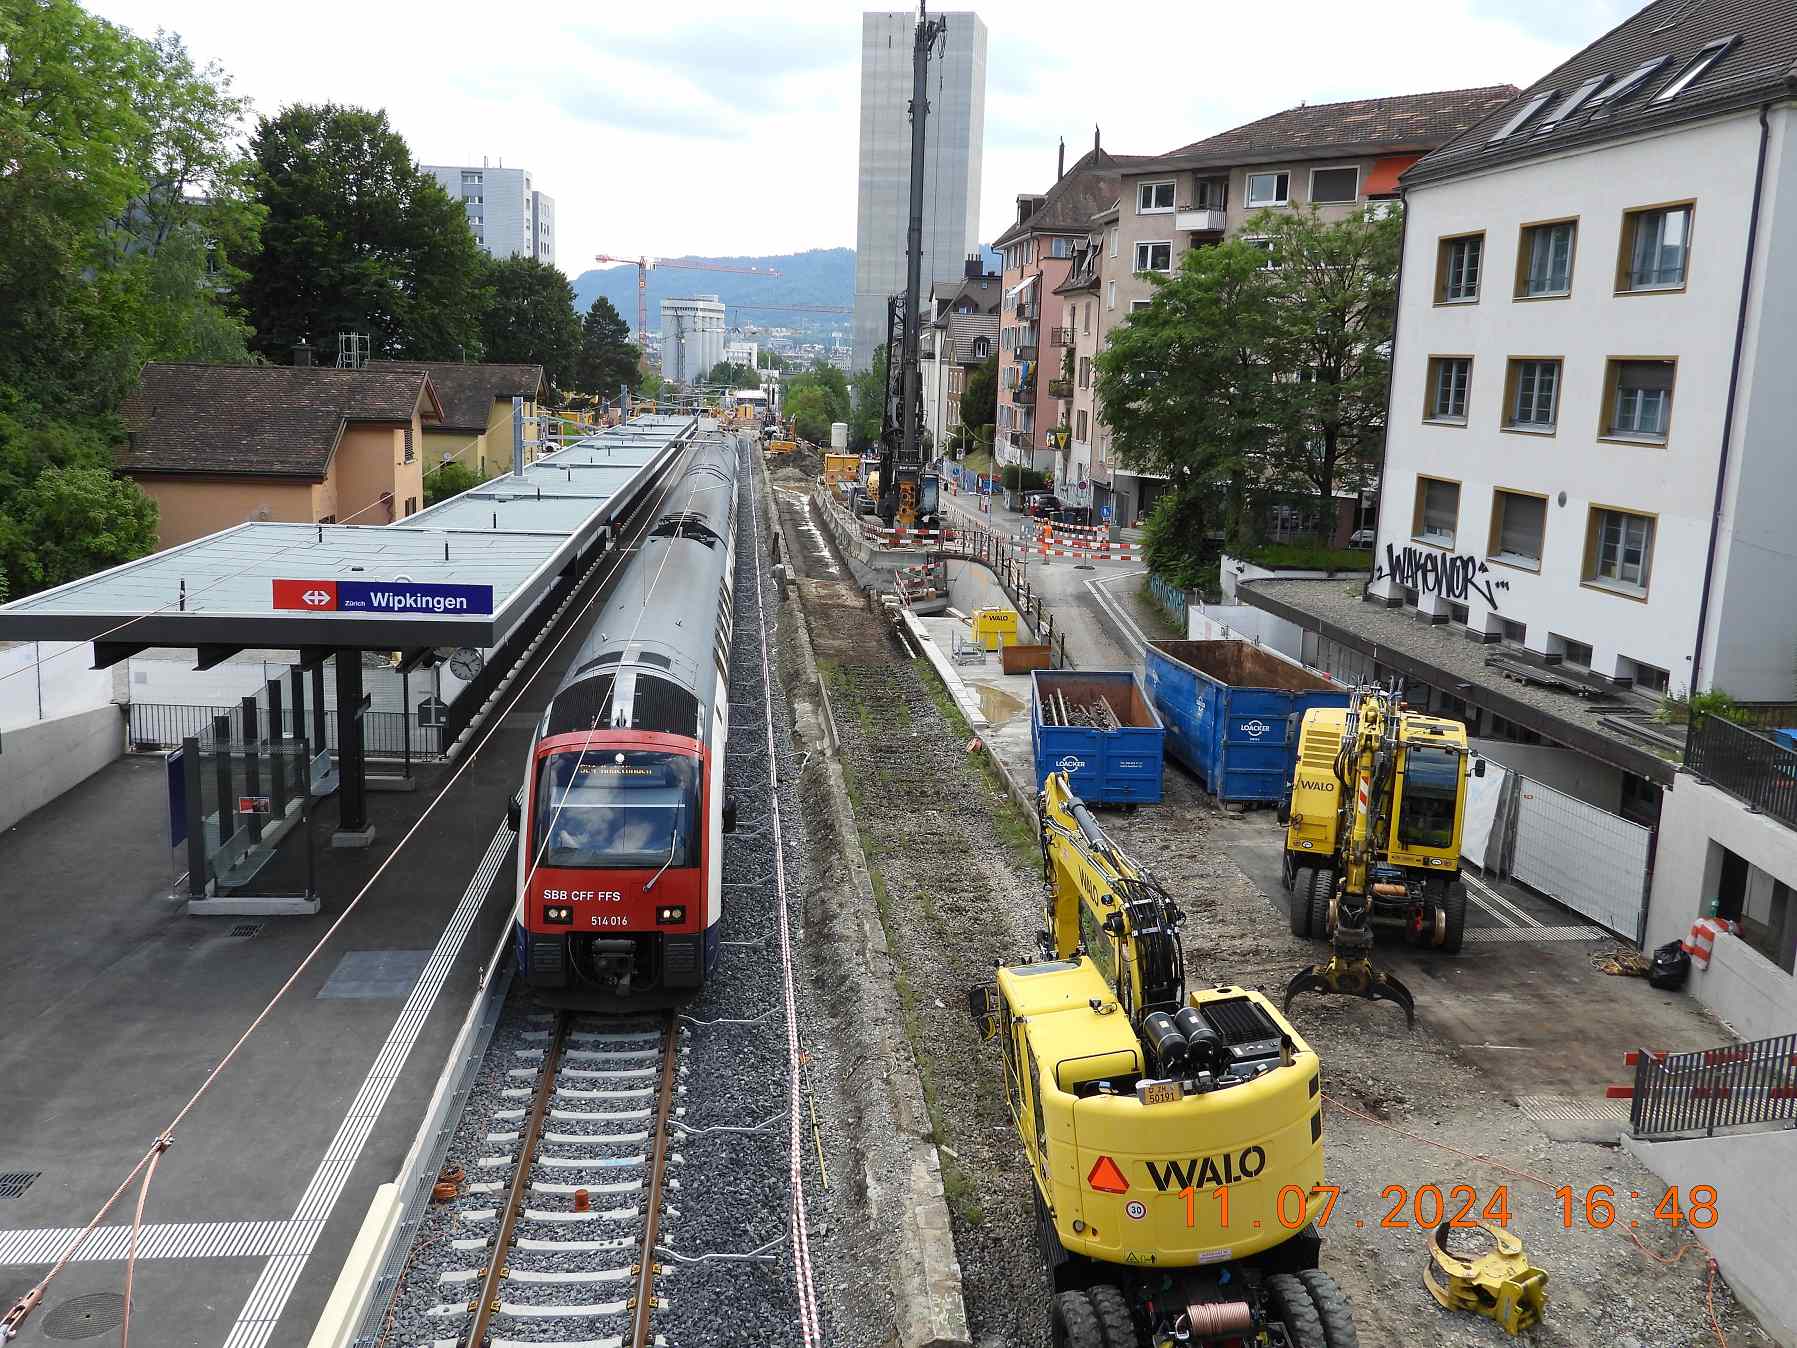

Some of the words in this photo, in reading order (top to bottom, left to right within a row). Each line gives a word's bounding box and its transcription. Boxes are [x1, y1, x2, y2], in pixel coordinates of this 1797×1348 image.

[370, 591, 467, 611] Wipkingen
[1240, 724, 1270, 732] LOACKER
[1301, 780, 1335, 792] WALO
[1078, 864, 1099, 907] WALO
[543, 889, 567, 900] SBB
[571, 890, 594, 901] CFF
[598, 891, 621, 902] FFS
[591, 916, 608, 926] 514
[610, 916, 628, 926] 016
[1149, 1092, 1175, 1104] 50191
[1145, 1145, 1266, 1192] WALO
[1131, 1205, 1142, 1215] 30
